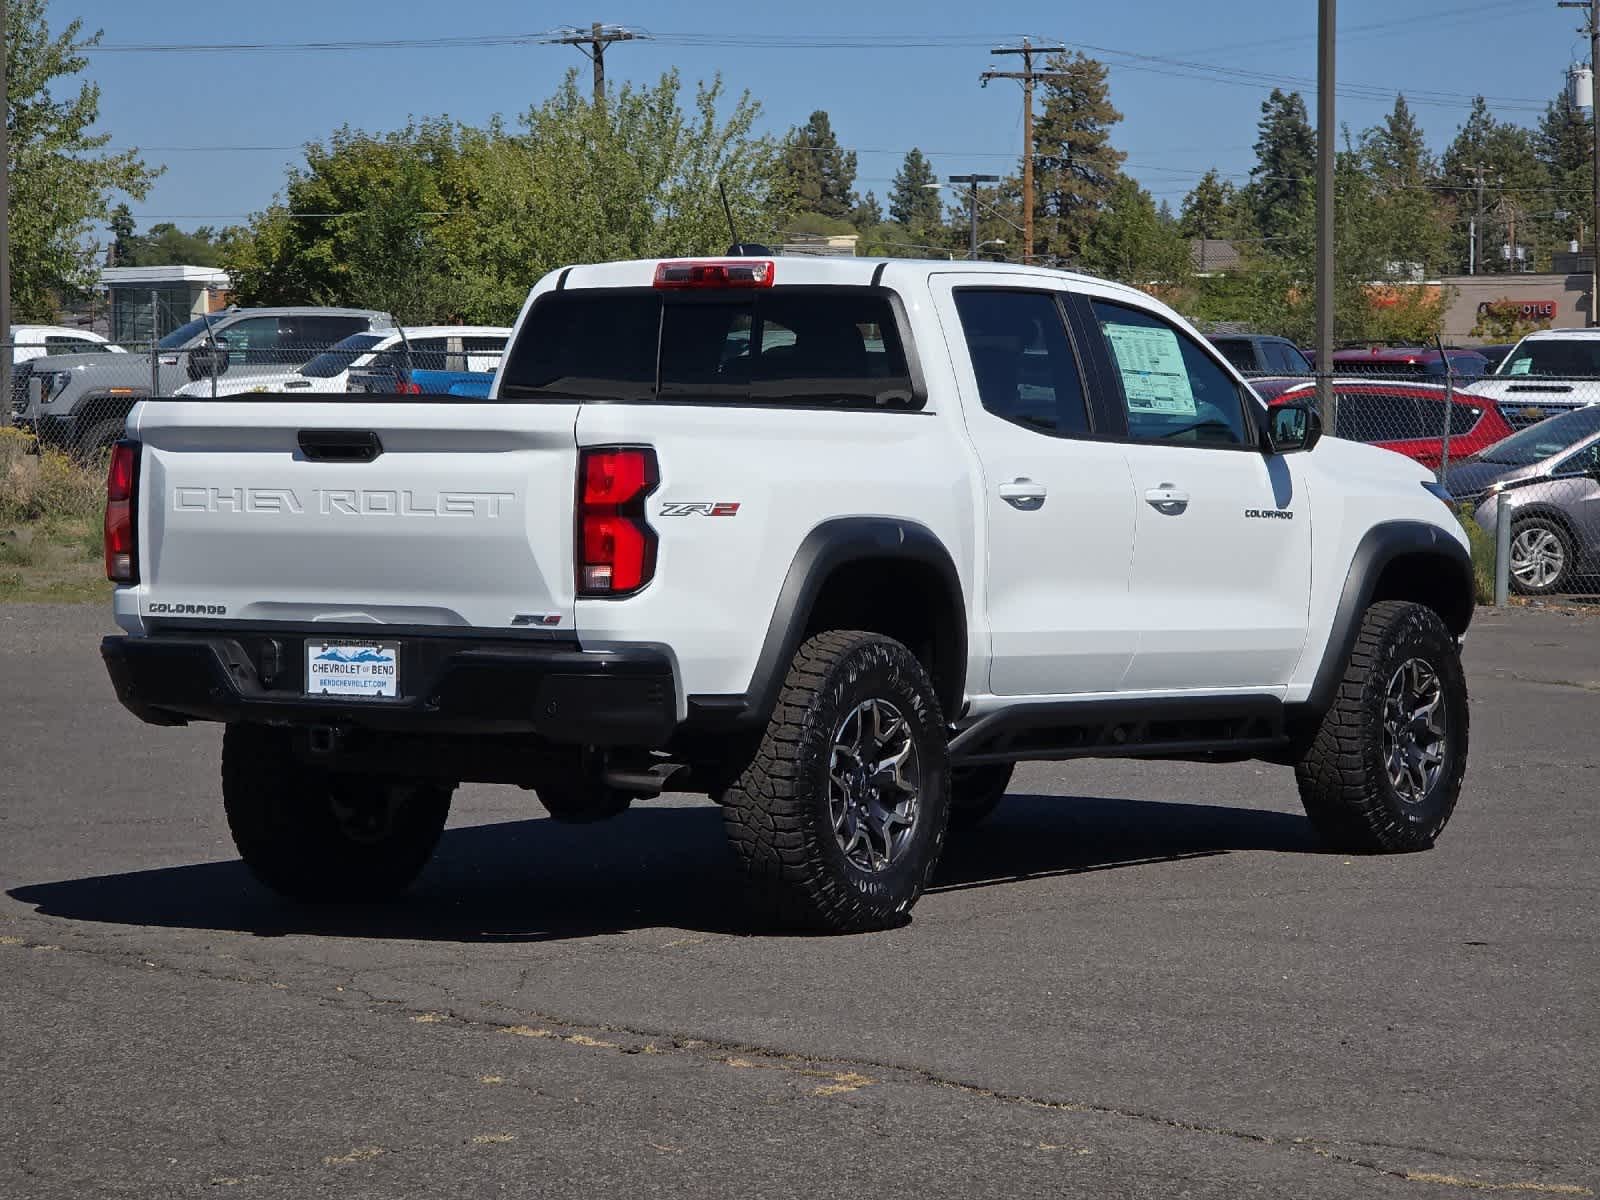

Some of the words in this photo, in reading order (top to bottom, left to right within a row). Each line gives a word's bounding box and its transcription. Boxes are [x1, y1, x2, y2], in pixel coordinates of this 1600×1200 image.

[173, 486, 515, 519] CHEVROLET
[659, 502, 741, 517] ZR2
[1244, 509, 1294, 520] COLORADO
[149, 603, 227, 615] COLORADO
[312, 663, 361, 675] CHEVROLET
[371, 665, 395, 675] BEND
[319, 679, 387, 688] BENDCHEVROLET.COM
